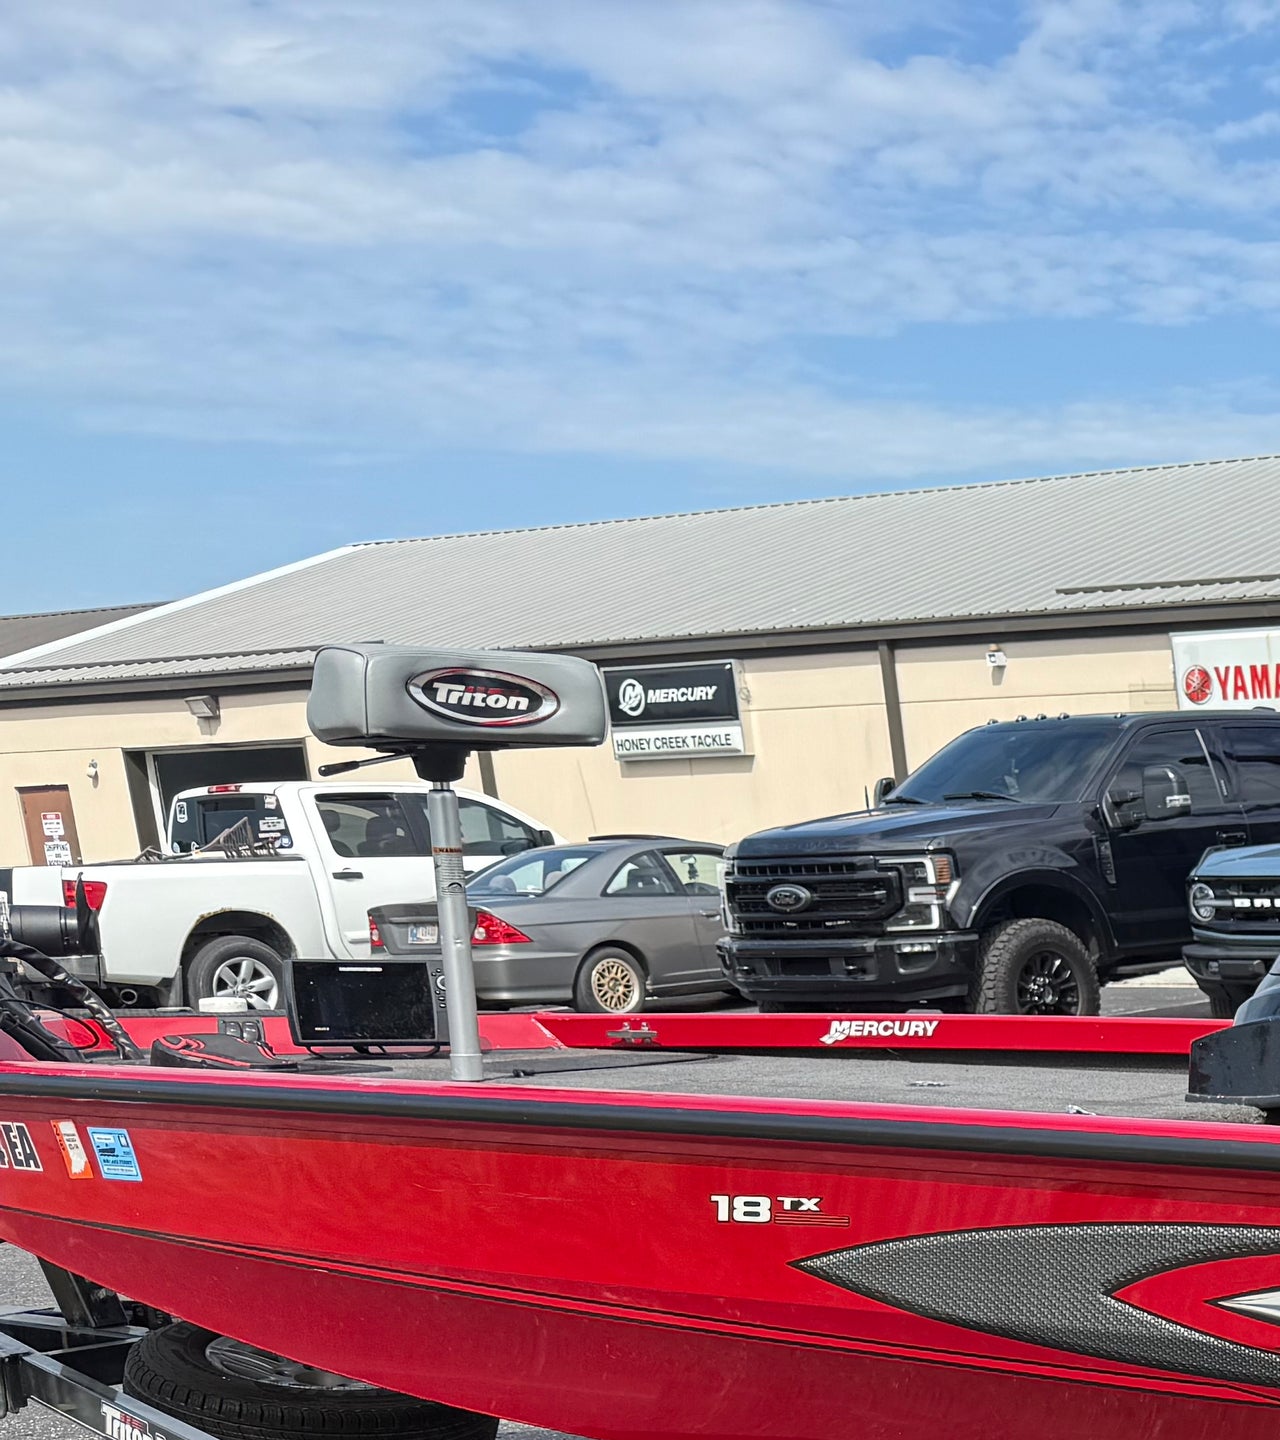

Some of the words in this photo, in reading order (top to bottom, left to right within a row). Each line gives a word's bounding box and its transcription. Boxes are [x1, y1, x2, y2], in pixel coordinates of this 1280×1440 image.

[431, 682, 530, 711] Triton
[646, 685, 718, 704] MERCURY
[616, 738, 651, 752] HONEY
[653, 736, 688, 750] CREEK
[690, 734, 732, 748] TACKLE
[820, 1020, 939, 1042] MERCURY
[1, 1123, 42, 1170] EA
[710, 1195, 772, 1223] 18
[776, 1196, 821, 1212] TX
